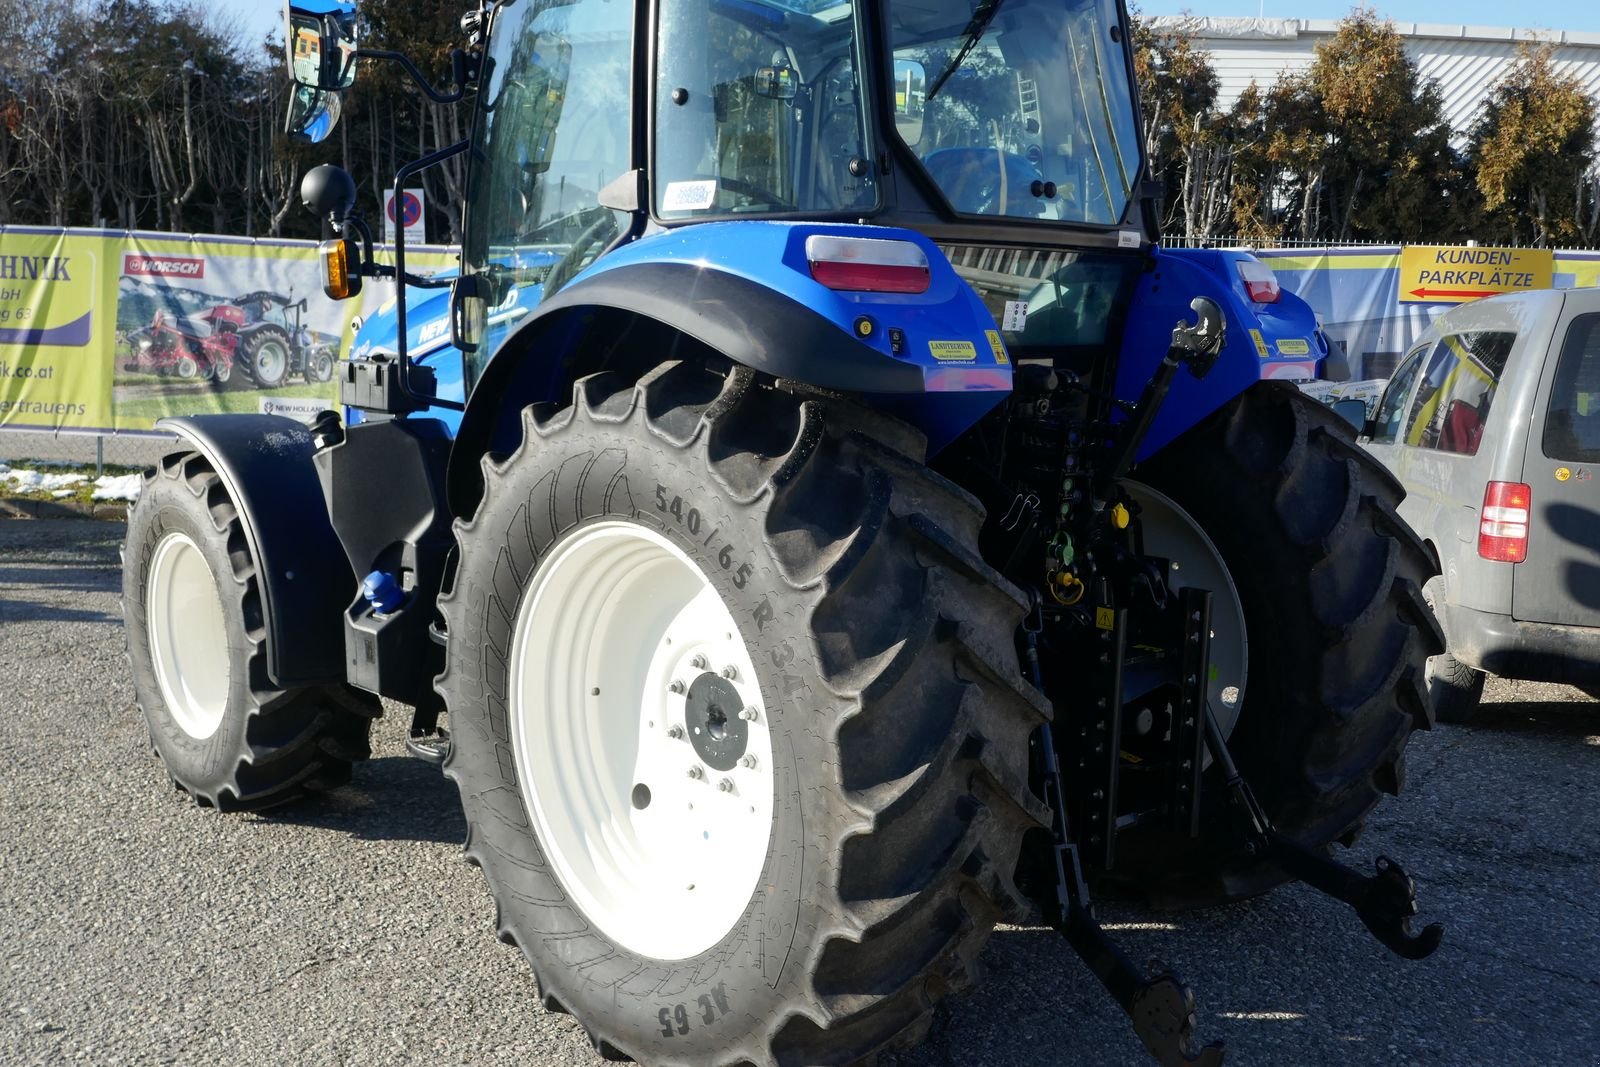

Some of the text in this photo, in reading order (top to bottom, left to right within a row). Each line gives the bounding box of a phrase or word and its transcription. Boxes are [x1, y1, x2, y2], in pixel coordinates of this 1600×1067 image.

[1435, 250, 1521, 265] KUNDEN-
[141, 260, 199, 274] HORSCH
[1418, 267, 1534, 287] PARKPLÄTZE
[275, 404, 292, 412] NEW
[655, 483, 754, 591] 540/65
[752, 598, 774, 633] R
[658, 1004, 690, 1038] 65
